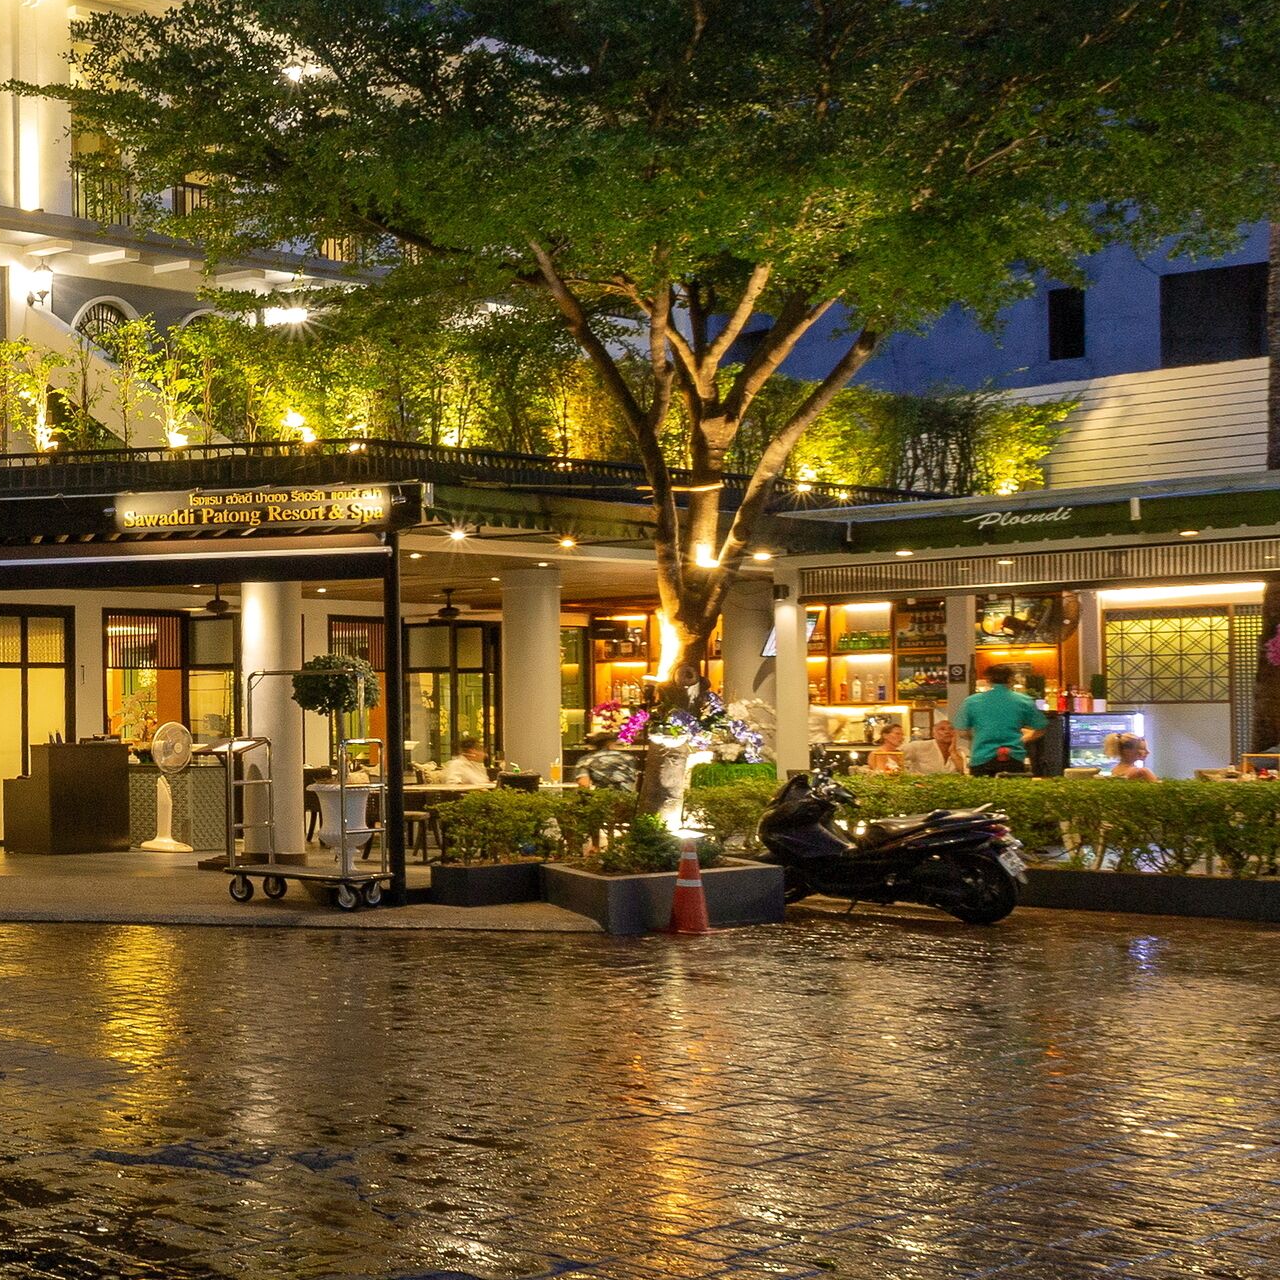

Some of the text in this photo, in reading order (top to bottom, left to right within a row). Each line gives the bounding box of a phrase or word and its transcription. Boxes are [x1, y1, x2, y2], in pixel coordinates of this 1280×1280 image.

[124, 503, 384, 527] Sawaddi Patong Resort & Spa
[962, 506, 1073, 530] Ploendi
